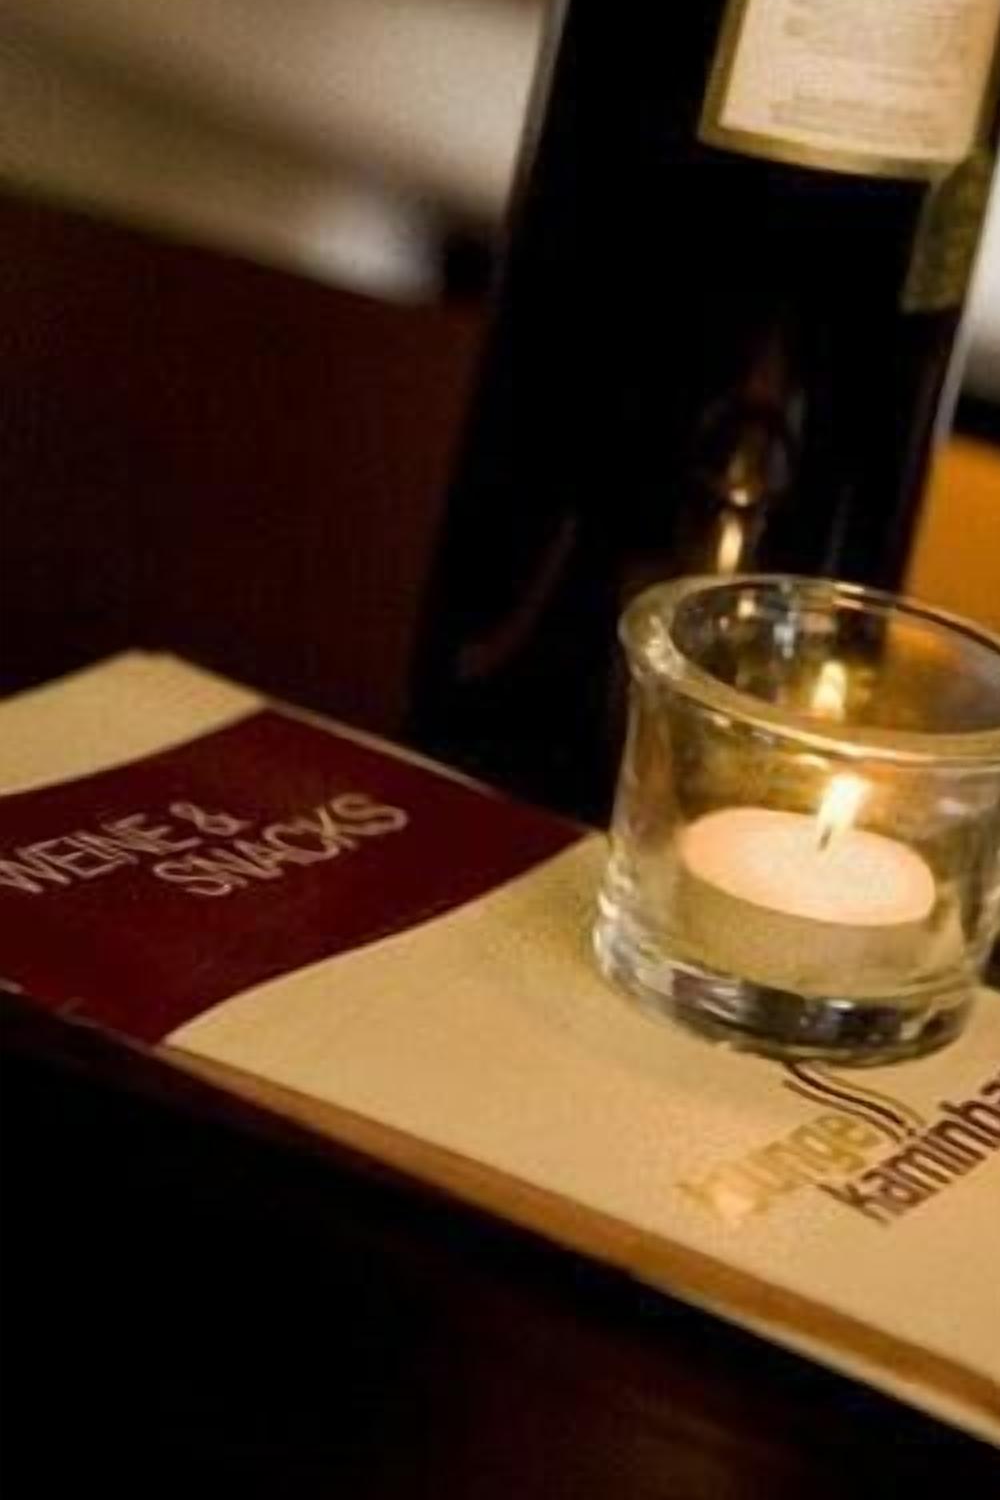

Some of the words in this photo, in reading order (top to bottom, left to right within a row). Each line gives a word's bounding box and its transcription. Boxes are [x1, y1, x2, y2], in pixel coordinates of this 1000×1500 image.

[0, 813, 201, 893] WEINE
[168, 801, 252, 837] &
[152, 793, 408, 896] SNACKS
